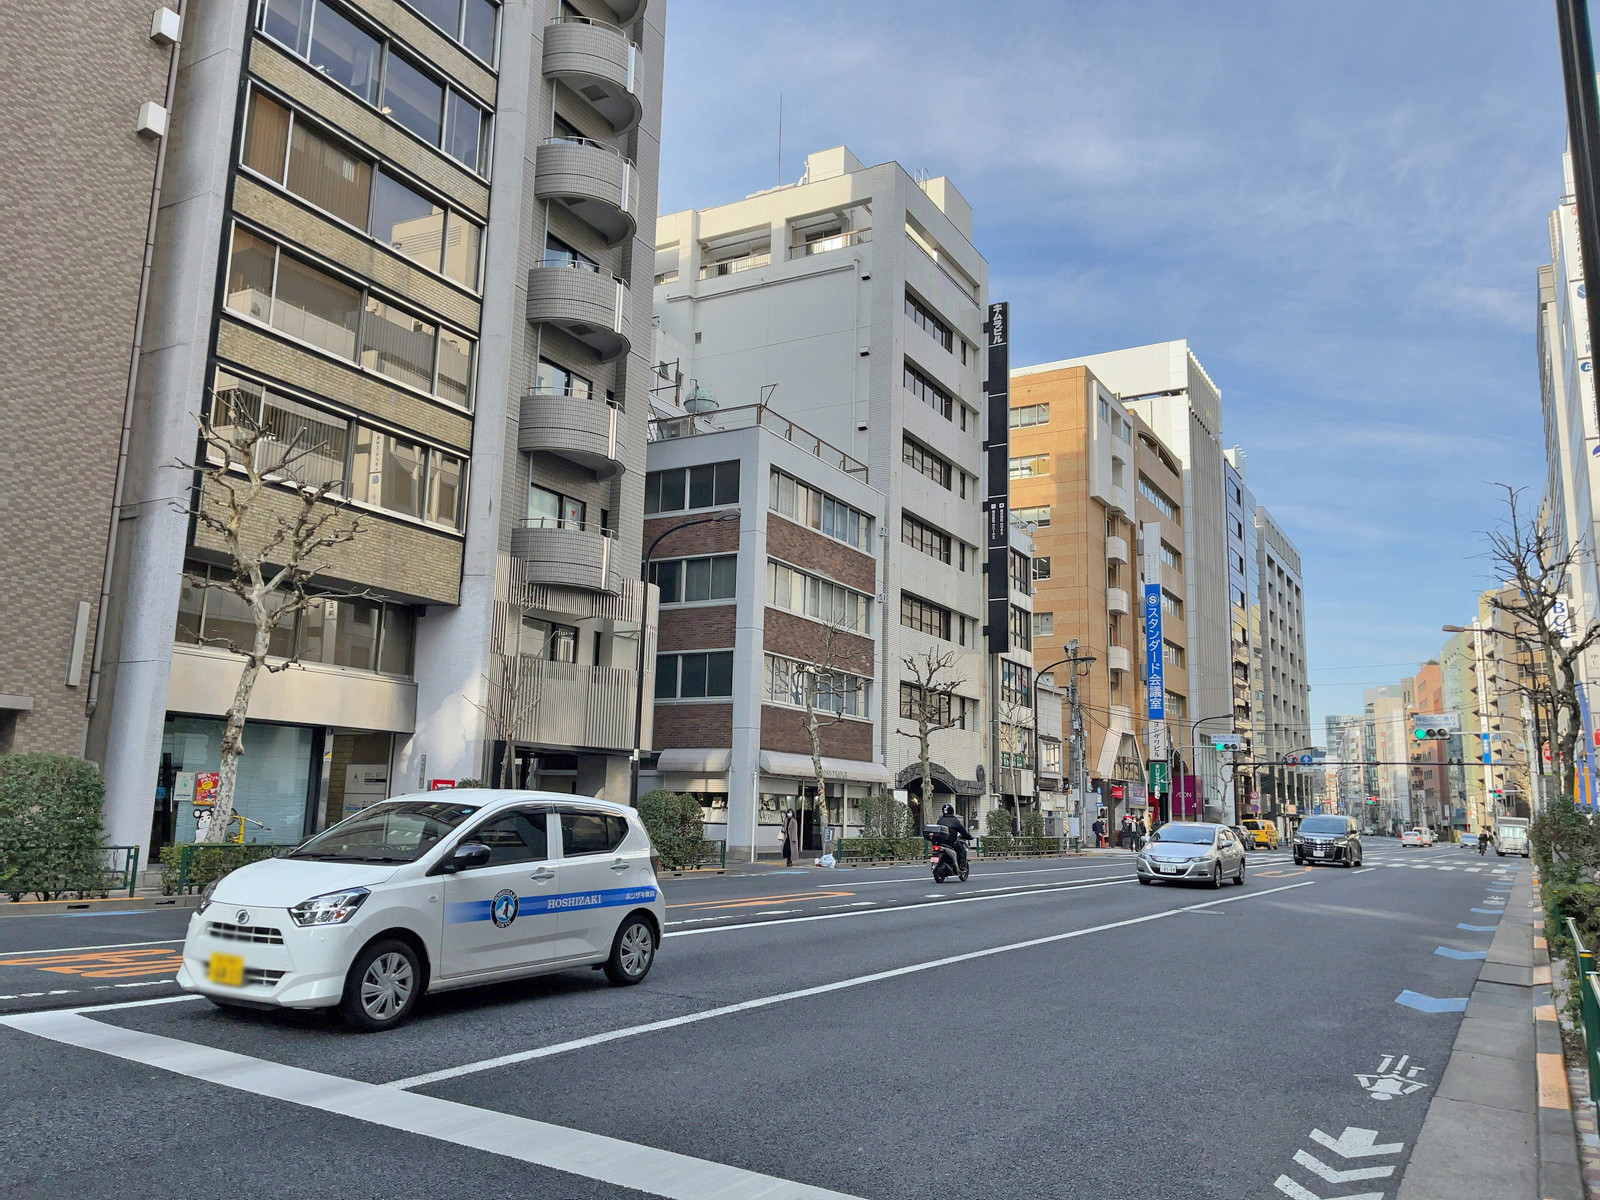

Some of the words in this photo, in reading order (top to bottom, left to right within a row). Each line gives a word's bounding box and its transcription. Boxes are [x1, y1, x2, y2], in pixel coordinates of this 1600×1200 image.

[993, 303, 1003, 344] キムラビル
[1148, 607, 1162, 710] スタンダード会議室
[547, 895, 602, 909] HOSHIZAKI
